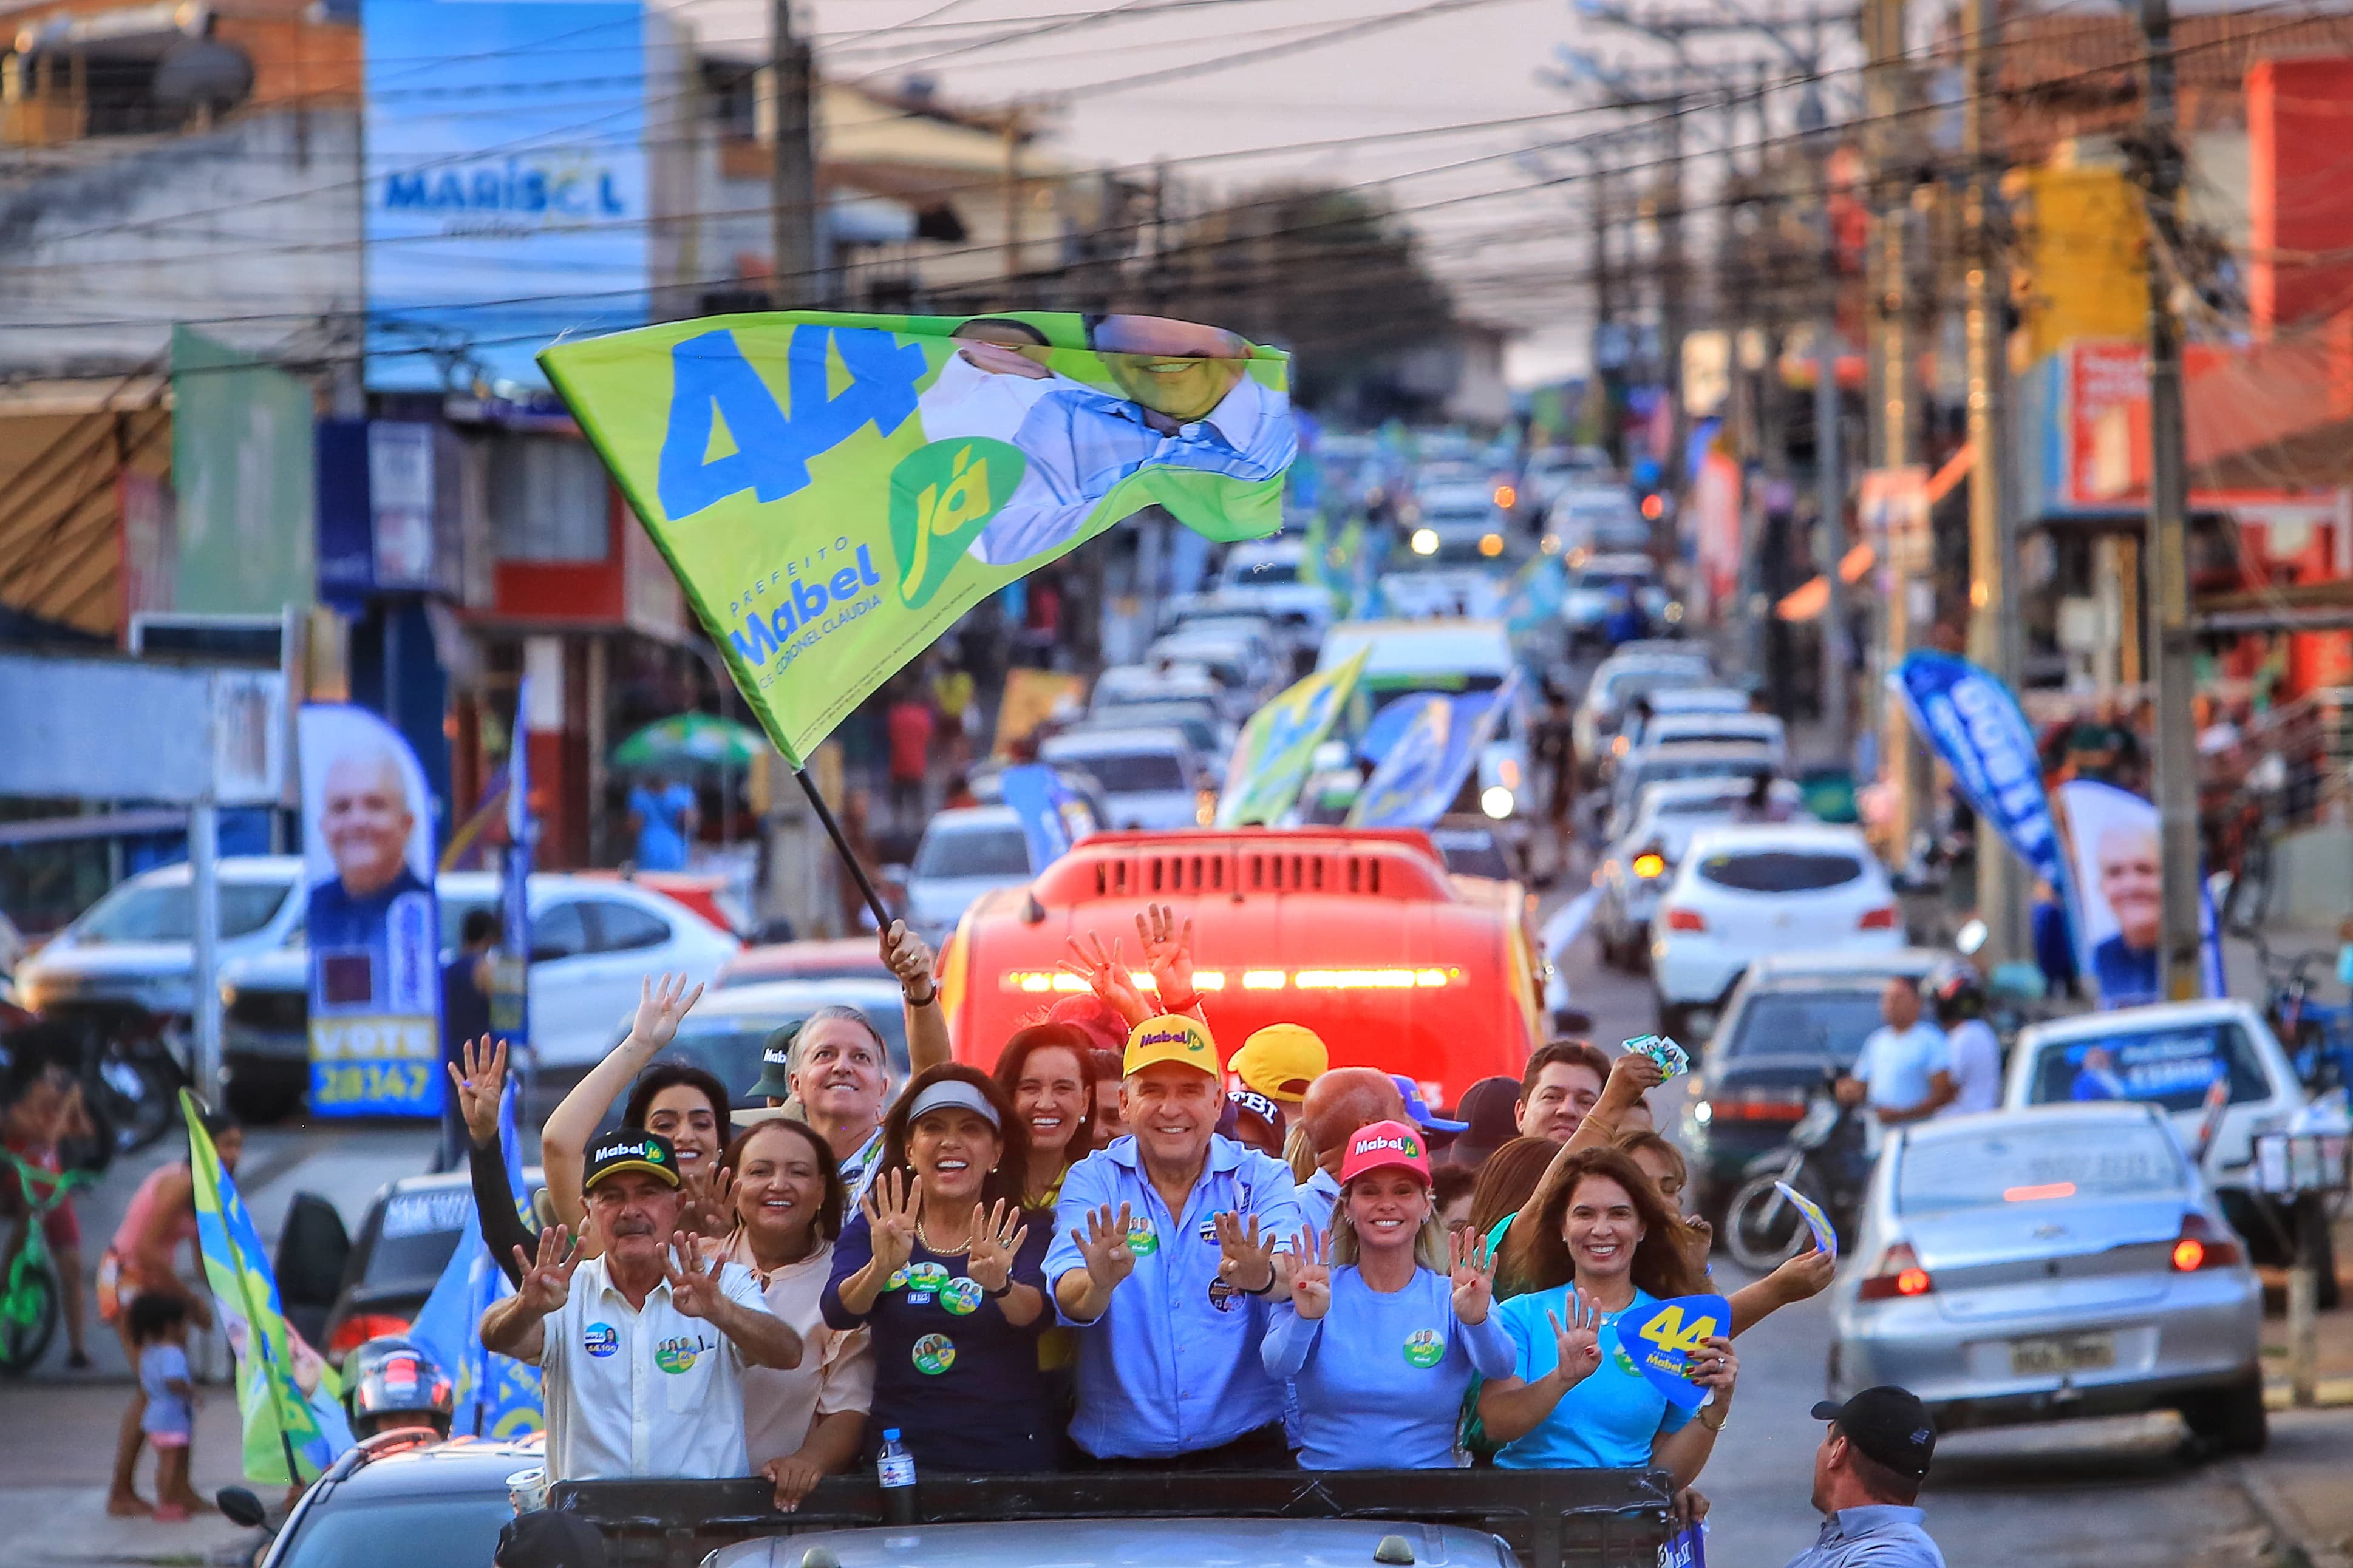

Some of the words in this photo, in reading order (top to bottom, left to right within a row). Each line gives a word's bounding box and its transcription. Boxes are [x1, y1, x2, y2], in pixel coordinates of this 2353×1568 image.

[658, 324, 928, 521] 44
[730, 536, 849, 617] PREFEITO
[729, 543, 882, 667] Mabel
[776, 629, 822, 675] CORONEL
[822, 594, 882, 635] CLÁUDIA
[312, 1022, 432, 1057] VOTE
[763, 1048, 788, 1064] Mab
[1139, 1030, 1187, 1048] Mabel
[594, 1142, 645, 1163] Mabel
[1355, 1136, 1404, 1156] Mabel
[1639, 1305, 1718, 1362] 44
[1646, 1353, 1683, 1373] Mabel
